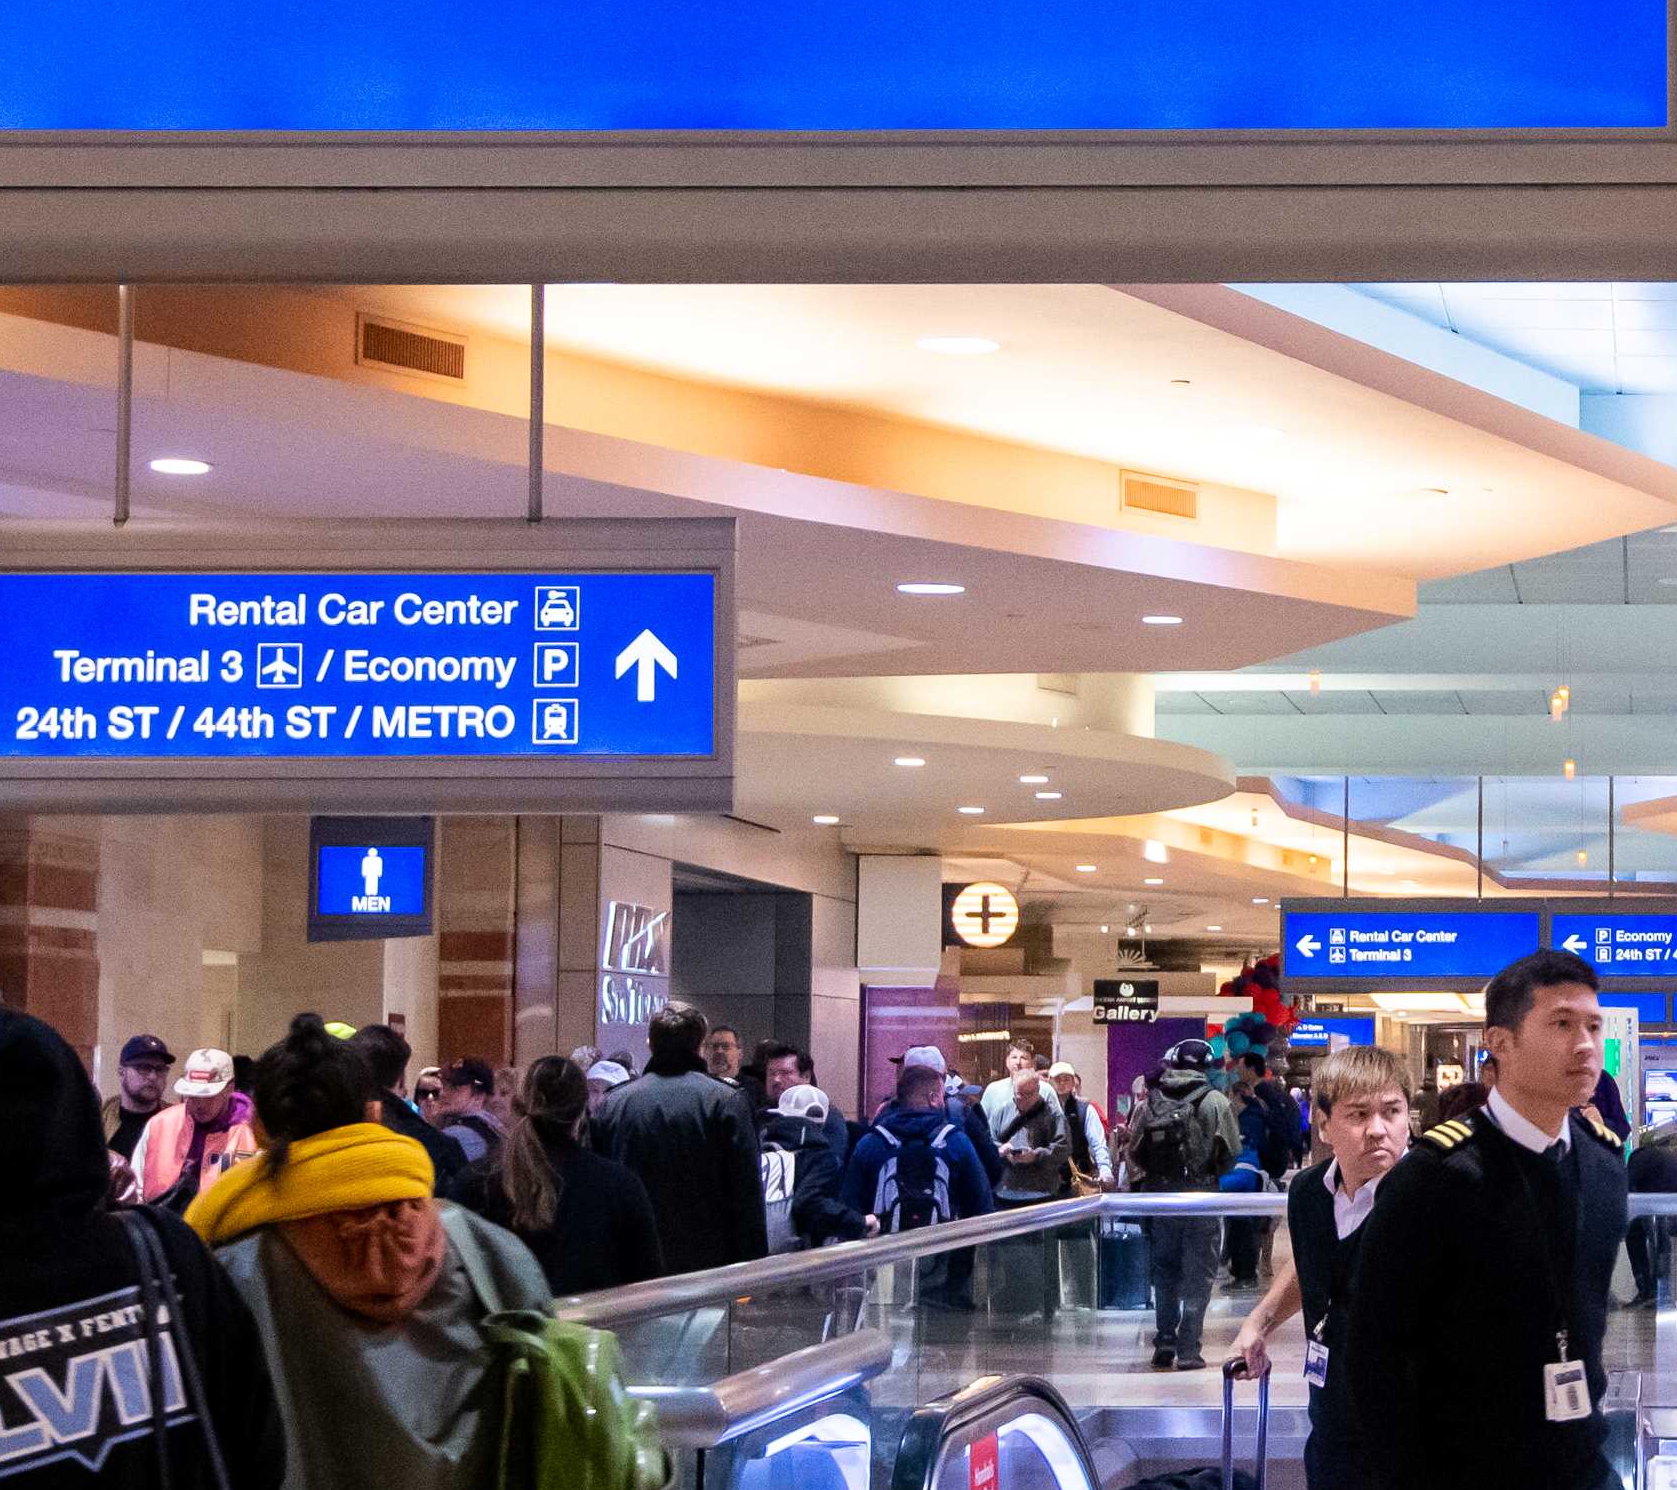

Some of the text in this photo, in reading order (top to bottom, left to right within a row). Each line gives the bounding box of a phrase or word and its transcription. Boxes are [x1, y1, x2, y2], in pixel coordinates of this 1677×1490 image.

[189, 592, 519, 626] Rental Car Center
[53, 650, 209, 683] Terminal
[220, 649, 244, 683] 3
[316, 649, 335, 682] /
[344, 649, 517, 689] Economy
[16, 704, 516, 740] 24th ST / 44th ST / METRO
[351, 895, 392, 913] MEN
[1349, 929, 1458, 943] Rental Car Center
[1615, 930, 1673, 945] Economy
[1349, 948, 1412, 962] Terminal 3
[1615, 948, 1643, 961] 24th
[1645, 948, 1663, 961] ST
[1093, 1005, 1160, 1023] Gallery
[55, 1324, 77, 1346] X
